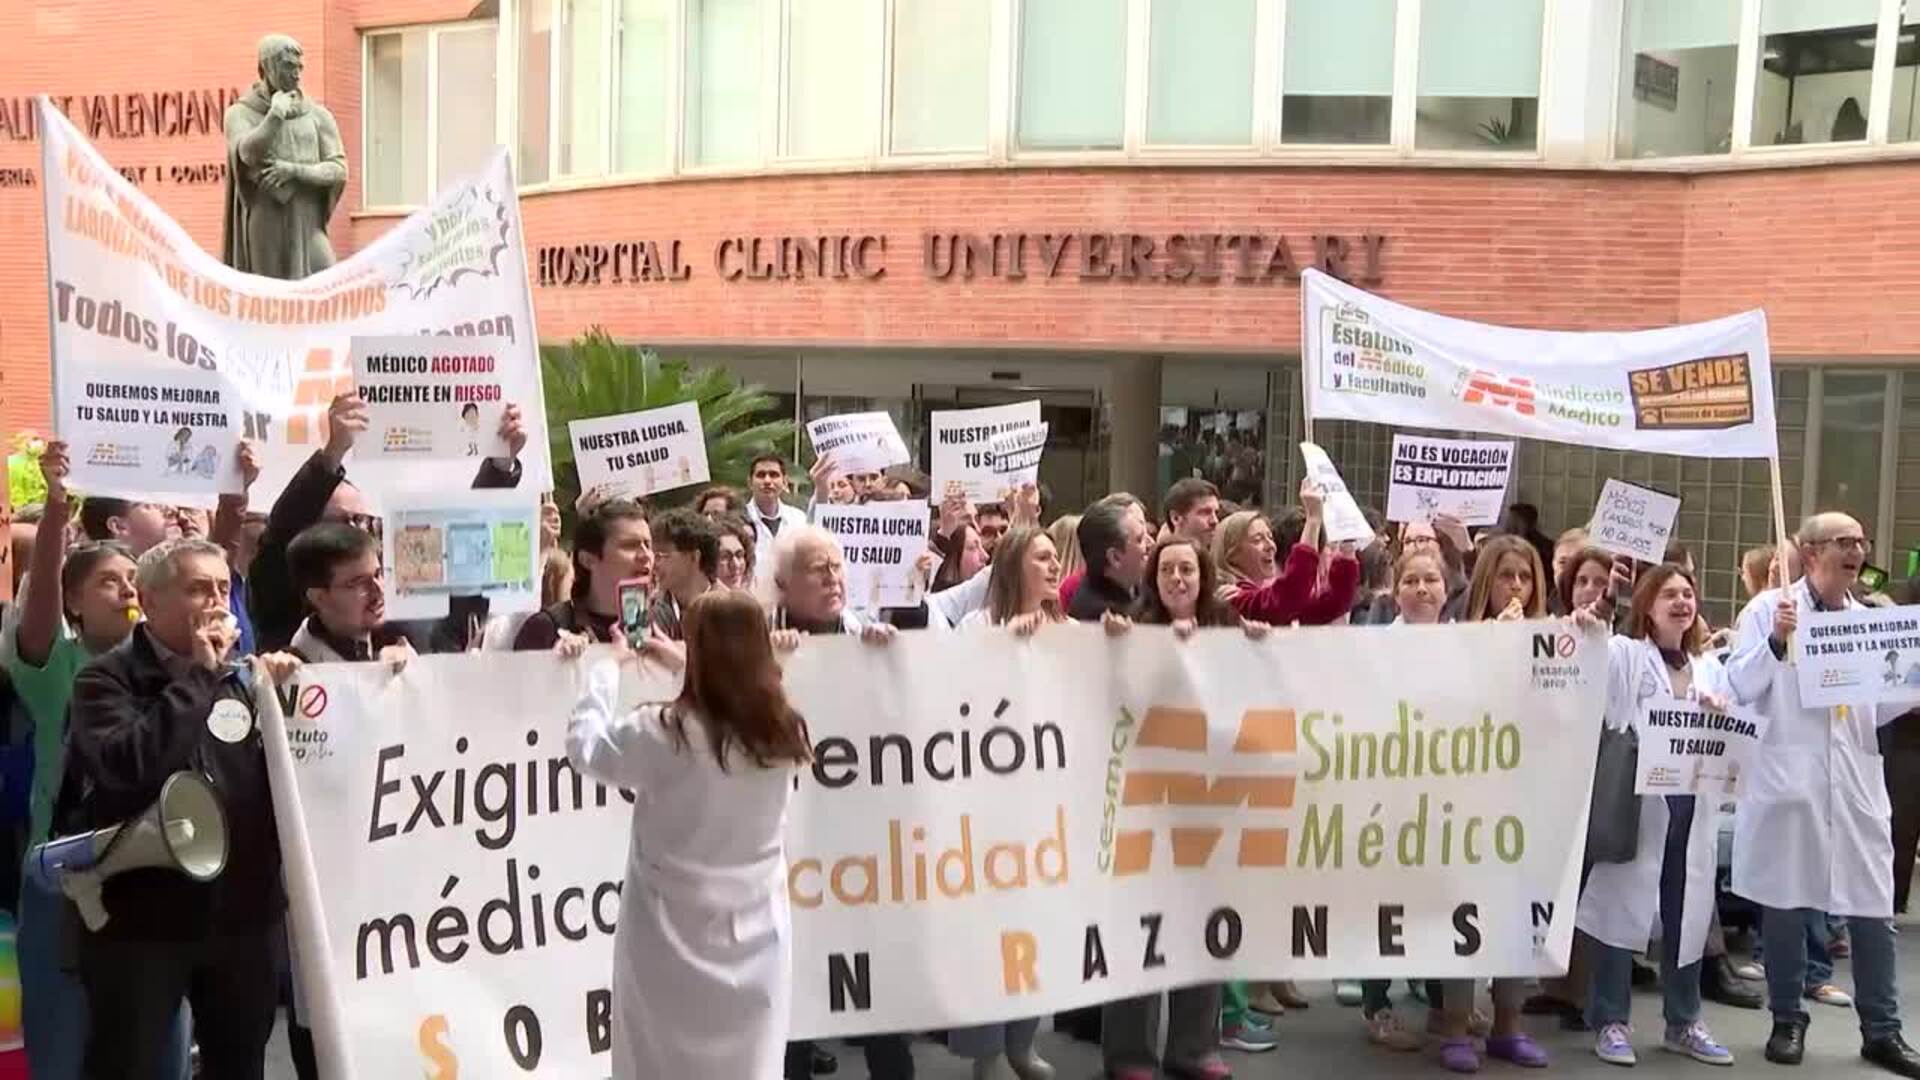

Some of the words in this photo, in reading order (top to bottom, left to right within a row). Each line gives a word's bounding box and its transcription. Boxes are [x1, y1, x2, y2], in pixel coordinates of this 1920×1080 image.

[536, 239, 692, 287] HOSPITAL
[714, 234, 887, 282] CLINIC
[922, 231, 1386, 286] UNIVERSITARI
[195, 274, 233, 315] LOS
[55, 281, 159, 352] Todos
[166, 321, 217, 370] los
[367, 352, 427, 373] MÉDICO
[431, 356, 495, 373] AGOTADO
[1334, 351, 1355, 369] del
[1632, 371, 1664, 395] SE
[1667, 358, 1748, 391] VENDE
[86, 383, 158, 401] QUEREMOS
[161, 388, 220, 403] MEJORAR
[359, 385, 430, 403] PACIENTE
[434, 385, 451, 402] EN
[455, 384, 501, 402] RIESGO
[77, 406, 93, 421] TU
[97, 407, 140, 423] SALUD
[142, 408, 151, 423] Y
[154, 409, 169, 425] LA
[172, 410, 228, 428] NUESTRA
[579, 429, 640, 451] NUESTRA
[940, 424, 998, 445] NUESTRA
[606, 456, 625, 472] TU
[626, 447, 669, 468] SALUD
[964, 452, 980, 469] TU
[1398, 443, 1417, 460] NO
[1421, 445, 1438, 461] ES
[1441, 446, 1508, 465] VOCACIÓN
[1395, 464, 1412, 482] ES
[1415, 466, 1507, 488] EXPLOTACIÓN
[822, 516, 880, 536] NUESTRA
[843, 546, 859, 563] TU
[861, 546, 902, 565] SALUD
[1810, 623, 1867, 639] QUEREMOS
[1869, 619, 1918, 633] MEJORAR
[1805, 644, 1819, 656] TU
[1820, 641, 1854, 654] SALUD
[1855, 640, 1863, 652] Y
[1865, 639, 1878, 651] LA
[1648, 709, 1705, 729] NUESTRA
[1301, 700, 1522, 782] Sindicato
[1669, 738, 1685, 755] TU
[1686, 739, 1726, 757] SALUD
[368, 730, 636, 850] Exigim
[794, 698, 1066, 791] ención
[1296, 793, 1525, 870] Médico
[787, 804, 1069, 909] calidad
